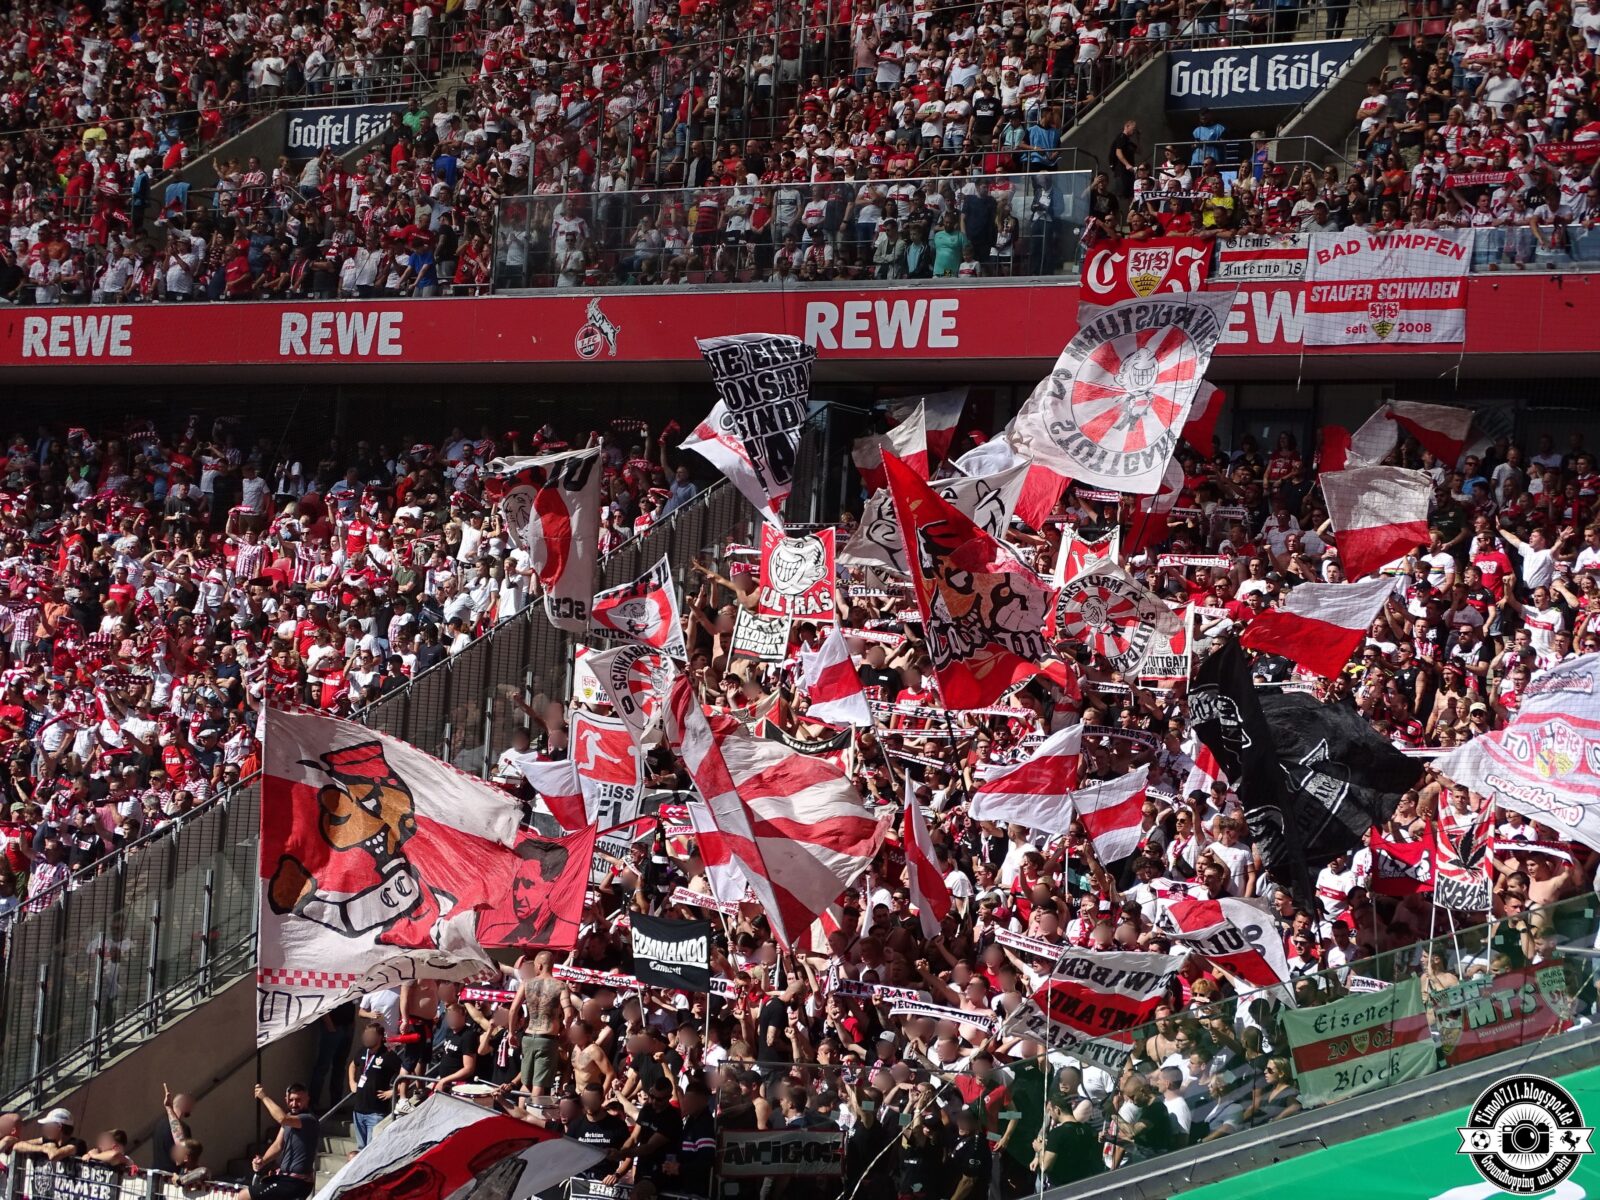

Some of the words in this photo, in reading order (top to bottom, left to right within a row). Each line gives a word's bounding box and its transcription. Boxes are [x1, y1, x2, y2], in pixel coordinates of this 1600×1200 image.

[1170, 56, 1261, 99] Gaffel
[1266, 48, 1362, 92] Köls
[288, 114, 350, 150] Gaffel
[1316, 240, 1361, 265] BAD
[1367, 234, 1467, 261] WIMPFEN
[1223, 263, 1281, 277] Inferno
[1310, 284, 1374, 302] STAUFER
[1376, 280, 1461, 301] SCHWABEN
[279, 312, 403, 356] REWE
[803, 299, 959, 349] REWE
[1218, 291, 1305, 344] EW
[1345, 323, 1368, 334] seit
[1398, 322, 1432, 333] 2008
[22, 314, 133, 358] REWE
[1313, 1000, 1400, 1034] Eisener
[1333, 1051, 1400, 1093] Block
[53, 1176, 112, 1200] IMMER
[80, 1164, 113, 1184] BIST
